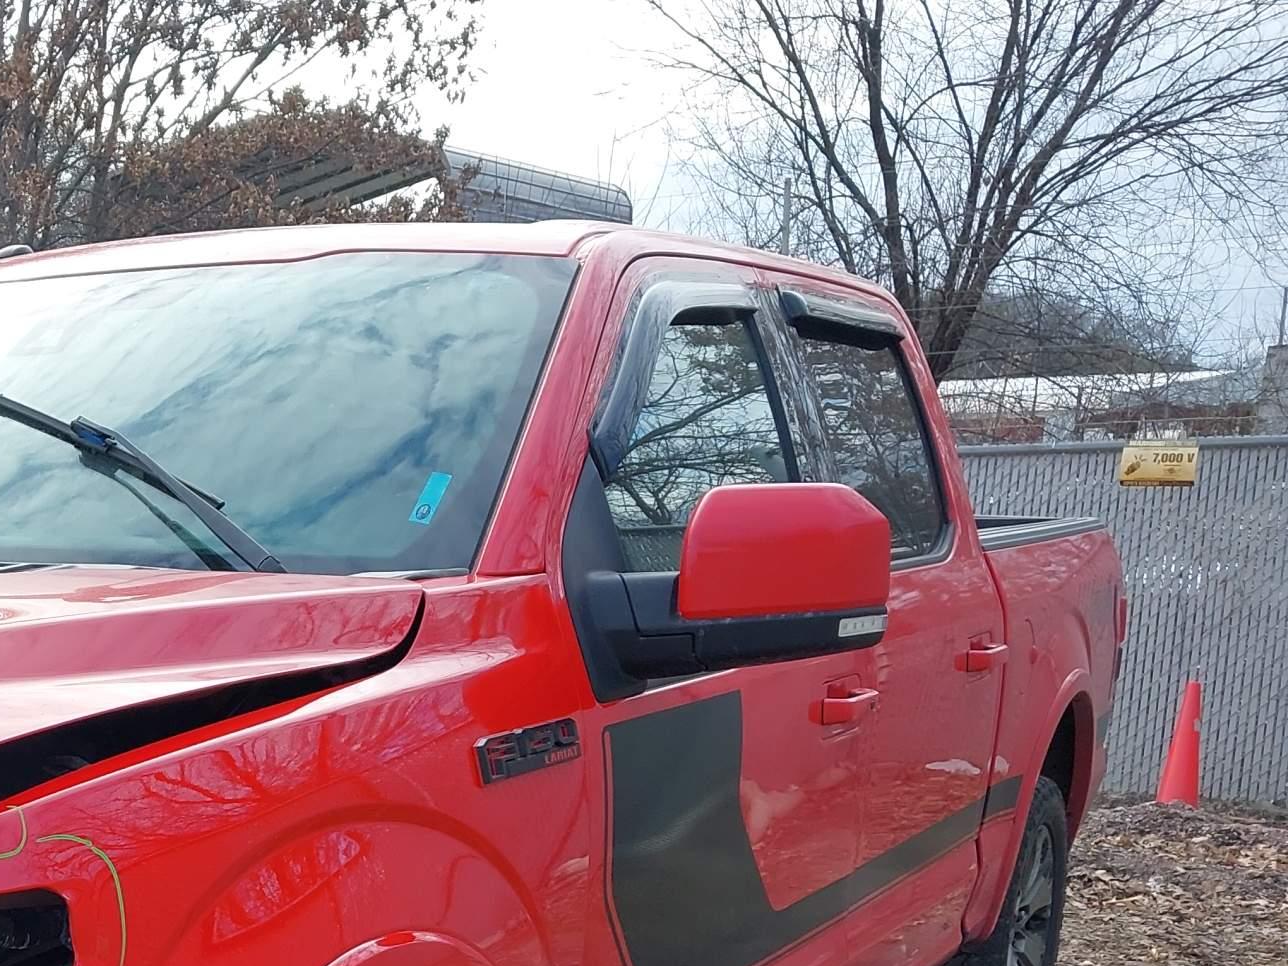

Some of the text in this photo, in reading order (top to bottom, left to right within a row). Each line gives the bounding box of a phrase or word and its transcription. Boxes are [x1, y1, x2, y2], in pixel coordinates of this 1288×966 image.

[1152, 452, 1195, 465] 7,000 V
[543, 745, 580, 764] LARIAT
